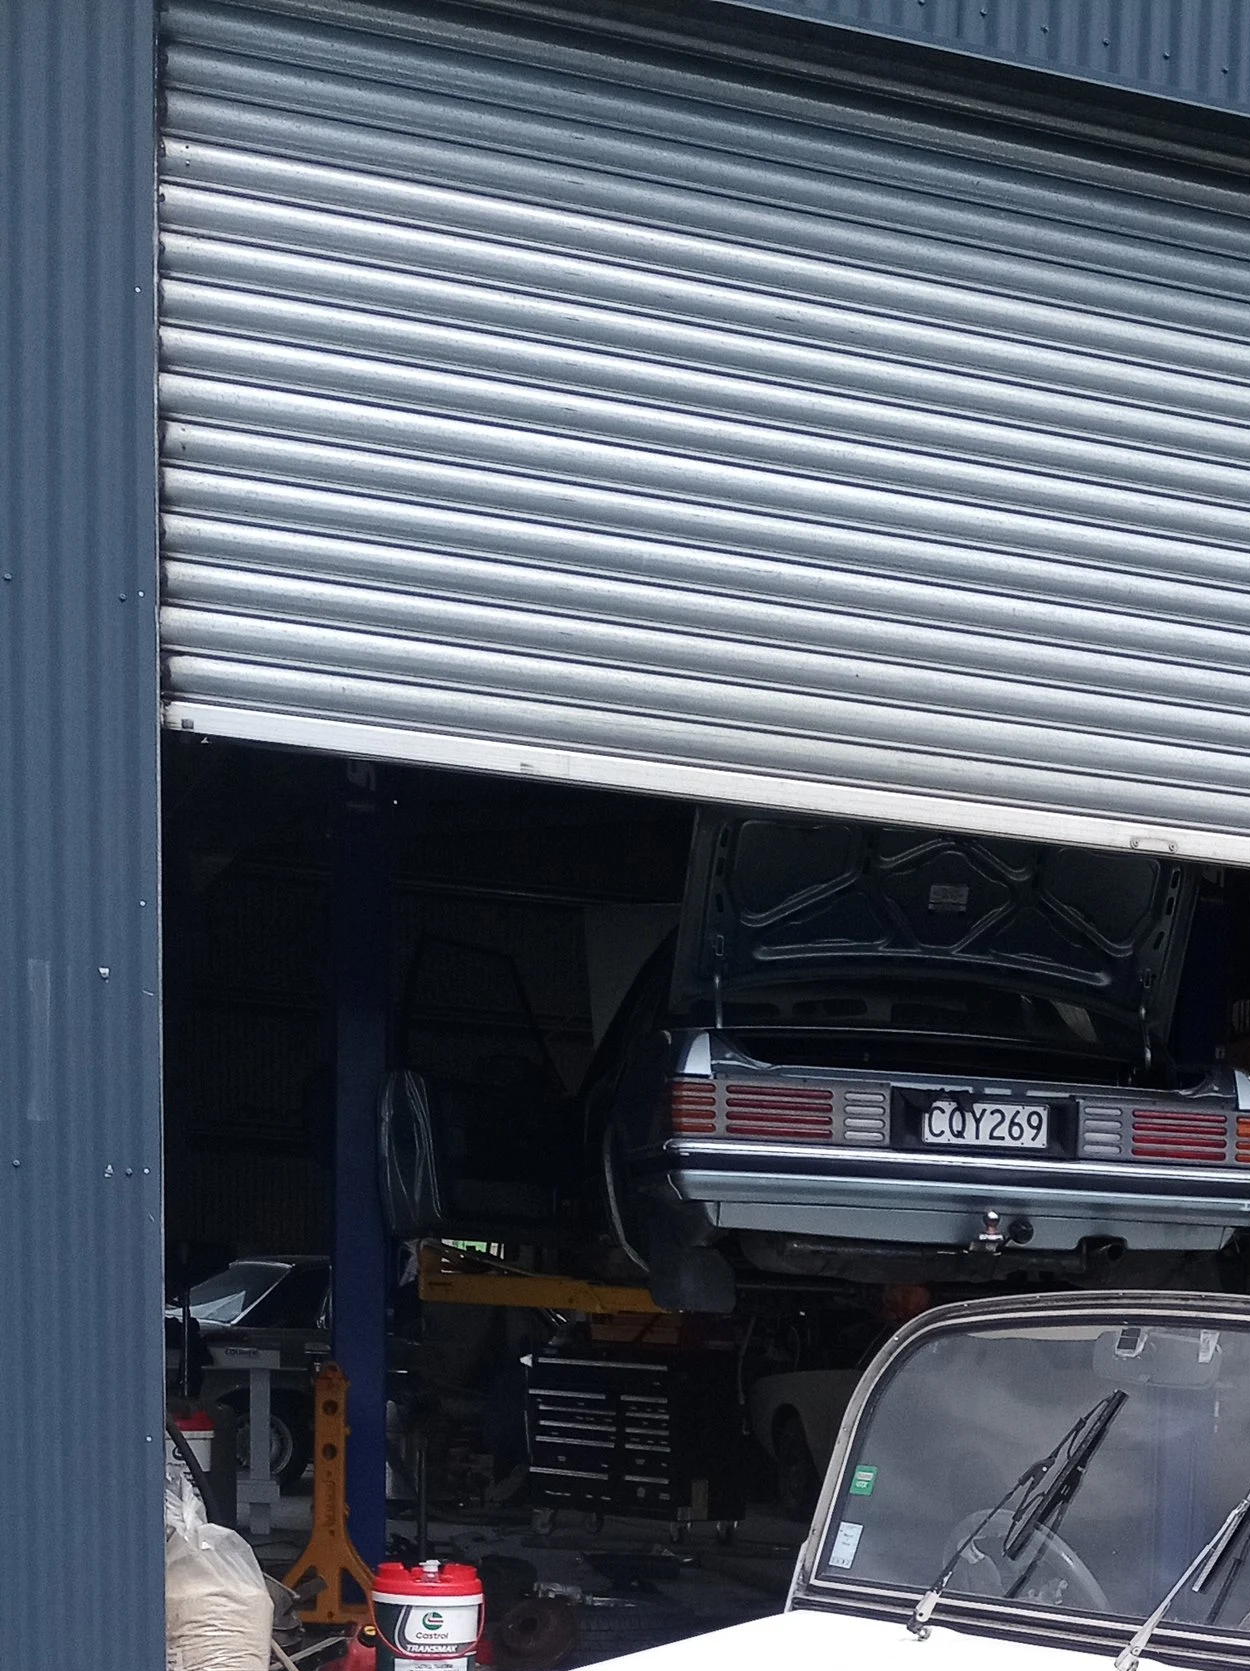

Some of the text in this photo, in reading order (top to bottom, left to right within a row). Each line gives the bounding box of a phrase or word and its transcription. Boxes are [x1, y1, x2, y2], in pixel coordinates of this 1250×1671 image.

[927, 1105, 1044, 1142] CQY269
[415, 1632, 449, 1640] Castrol
[405, 1644, 458, 1653] TRANSMAX
